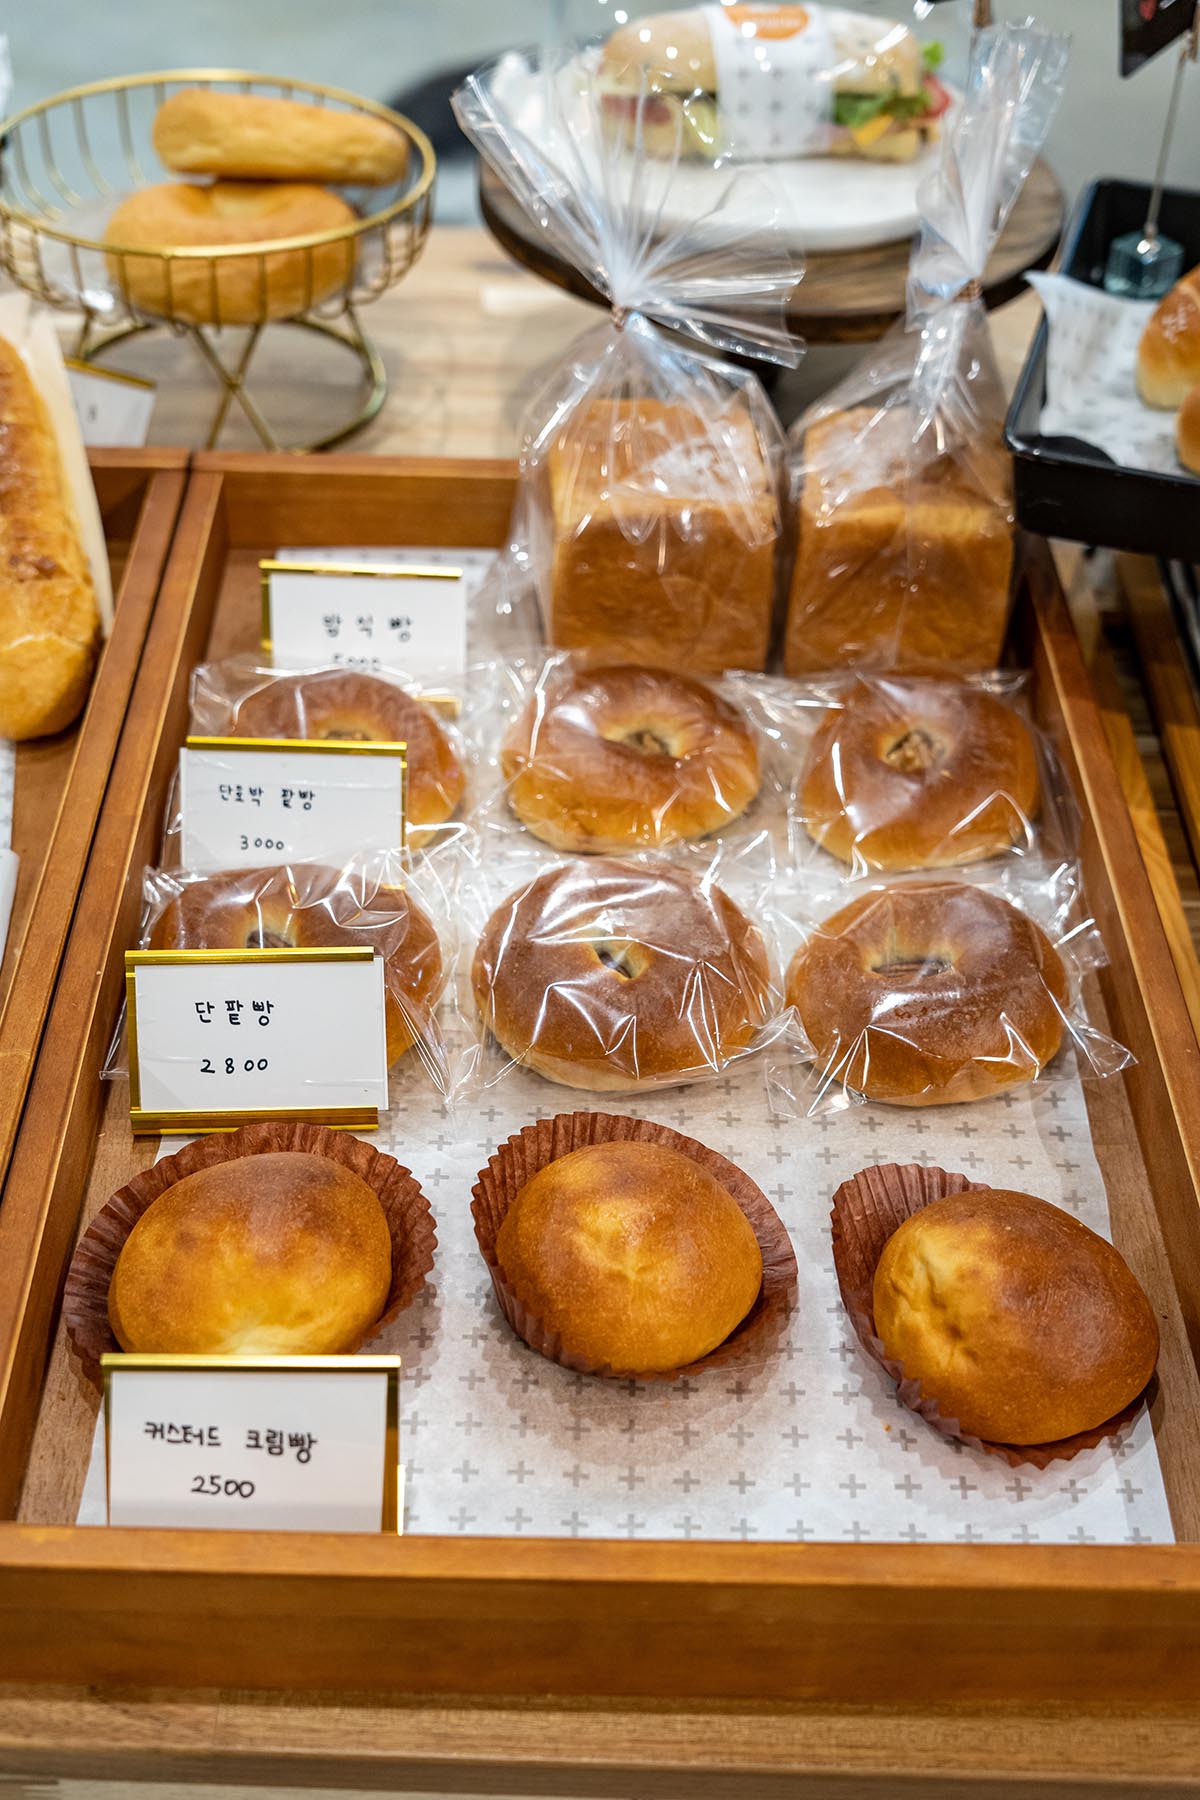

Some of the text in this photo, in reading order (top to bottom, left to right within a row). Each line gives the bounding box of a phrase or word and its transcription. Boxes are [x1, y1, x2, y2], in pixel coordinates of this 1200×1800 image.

[218, 783, 265, 807] 단호박
[239, 834, 285, 851] 3000
[194, 999, 275, 1027] 단팥빵
[199, 1057, 269, 1075] 2800
[143, 1420, 319, 1465] 커스터드 크림빵
[189, 1474, 257, 1500] 2500
